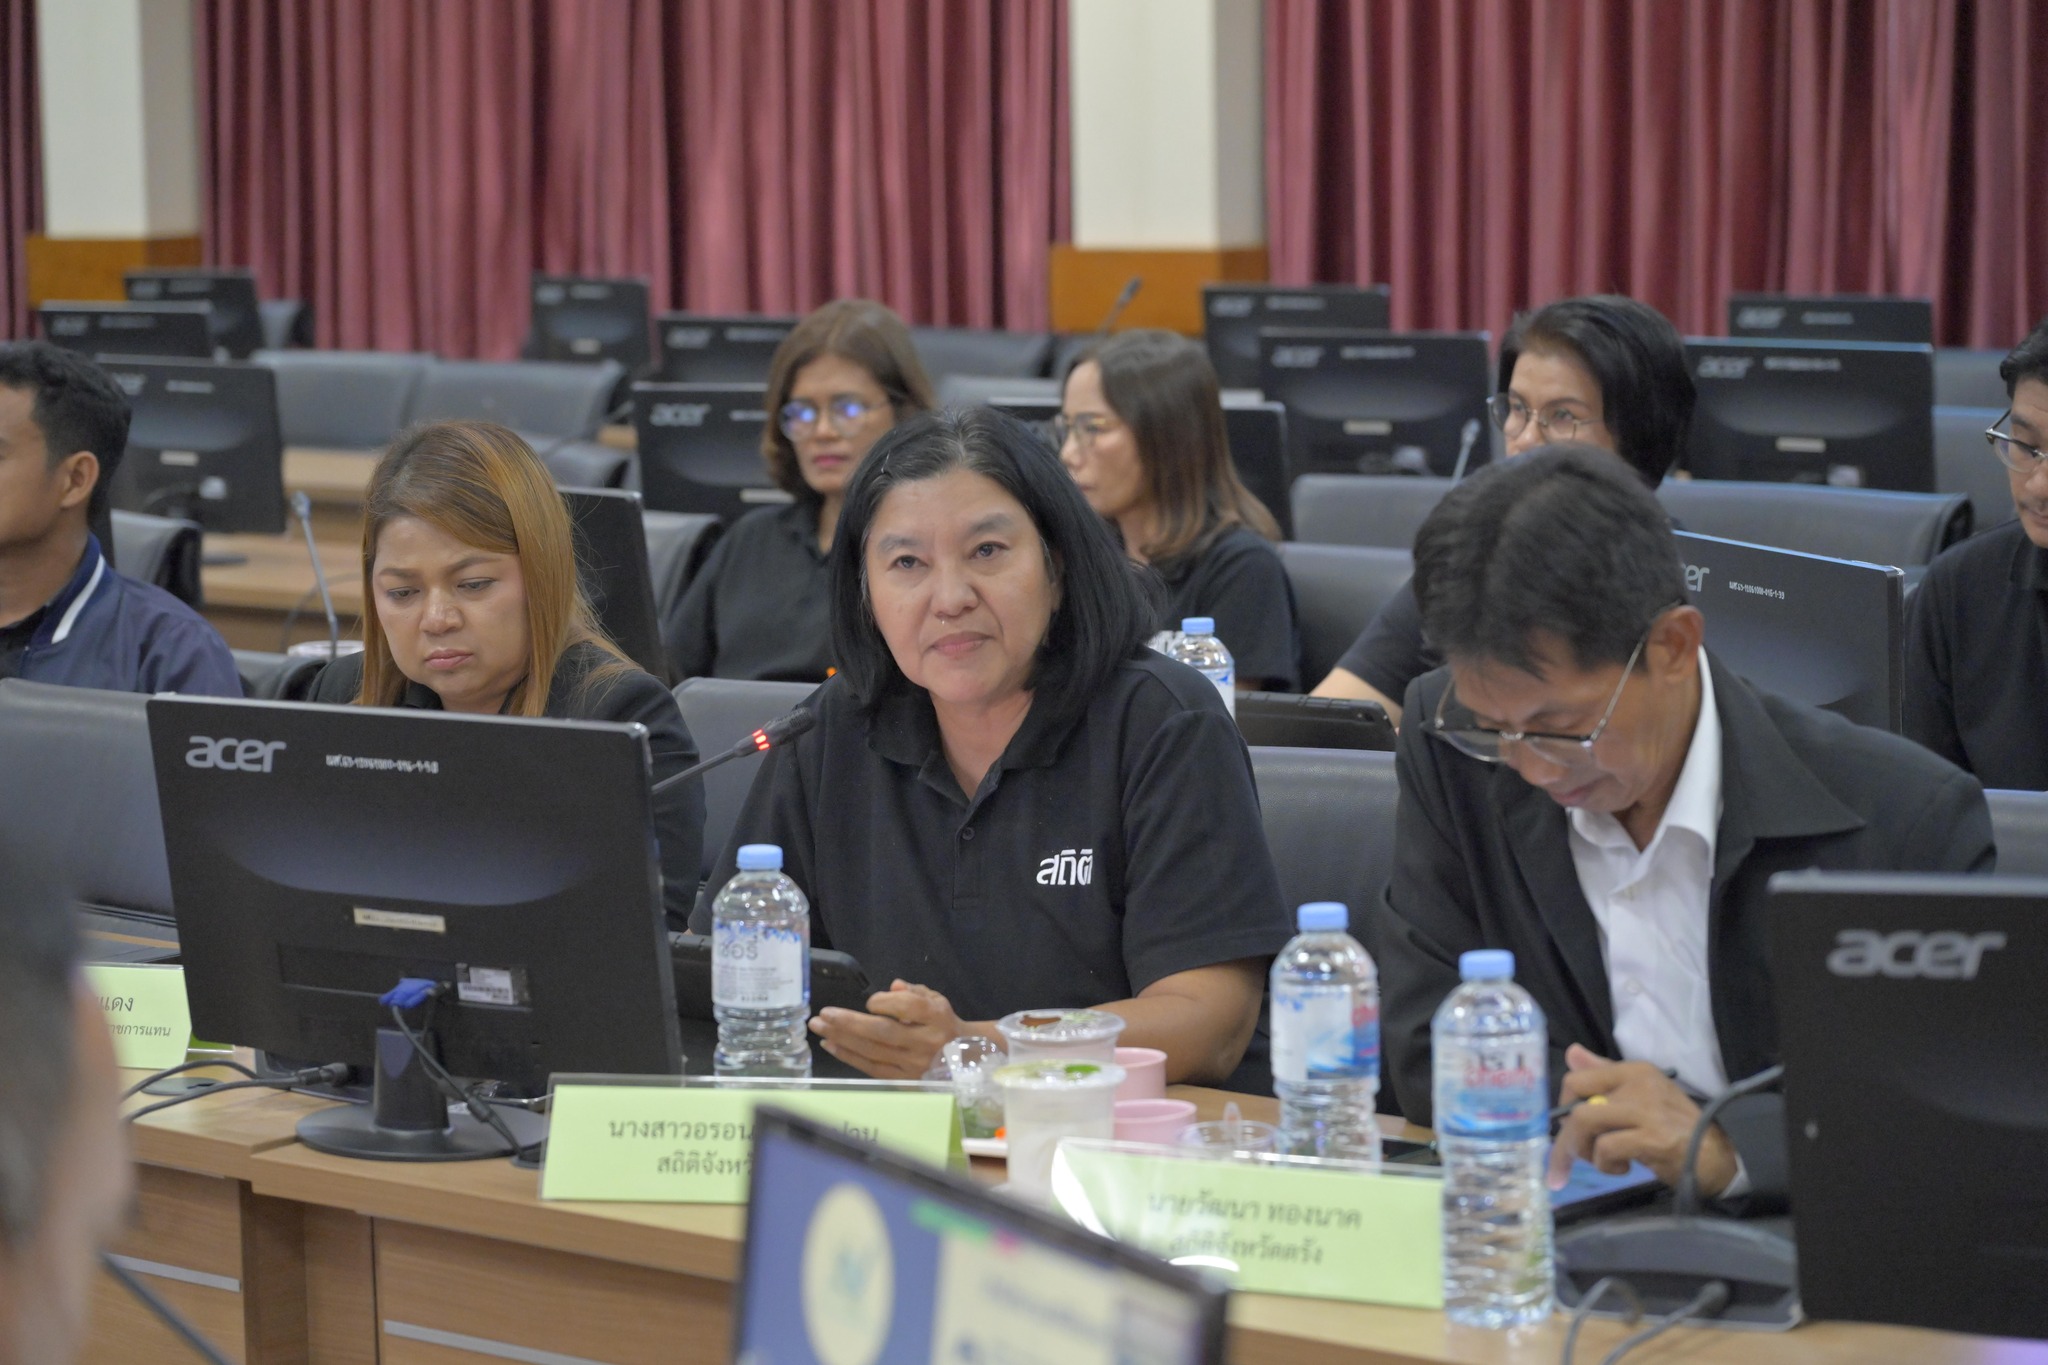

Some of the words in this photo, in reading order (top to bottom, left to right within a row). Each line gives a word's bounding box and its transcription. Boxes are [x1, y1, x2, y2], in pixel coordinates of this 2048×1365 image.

[1681, 563, 1710, 592] er
[185, 735, 287, 773] acer
[1826, 928, 2008, 980] acer
[110, 1023, 171, 1037] าชการแทน
